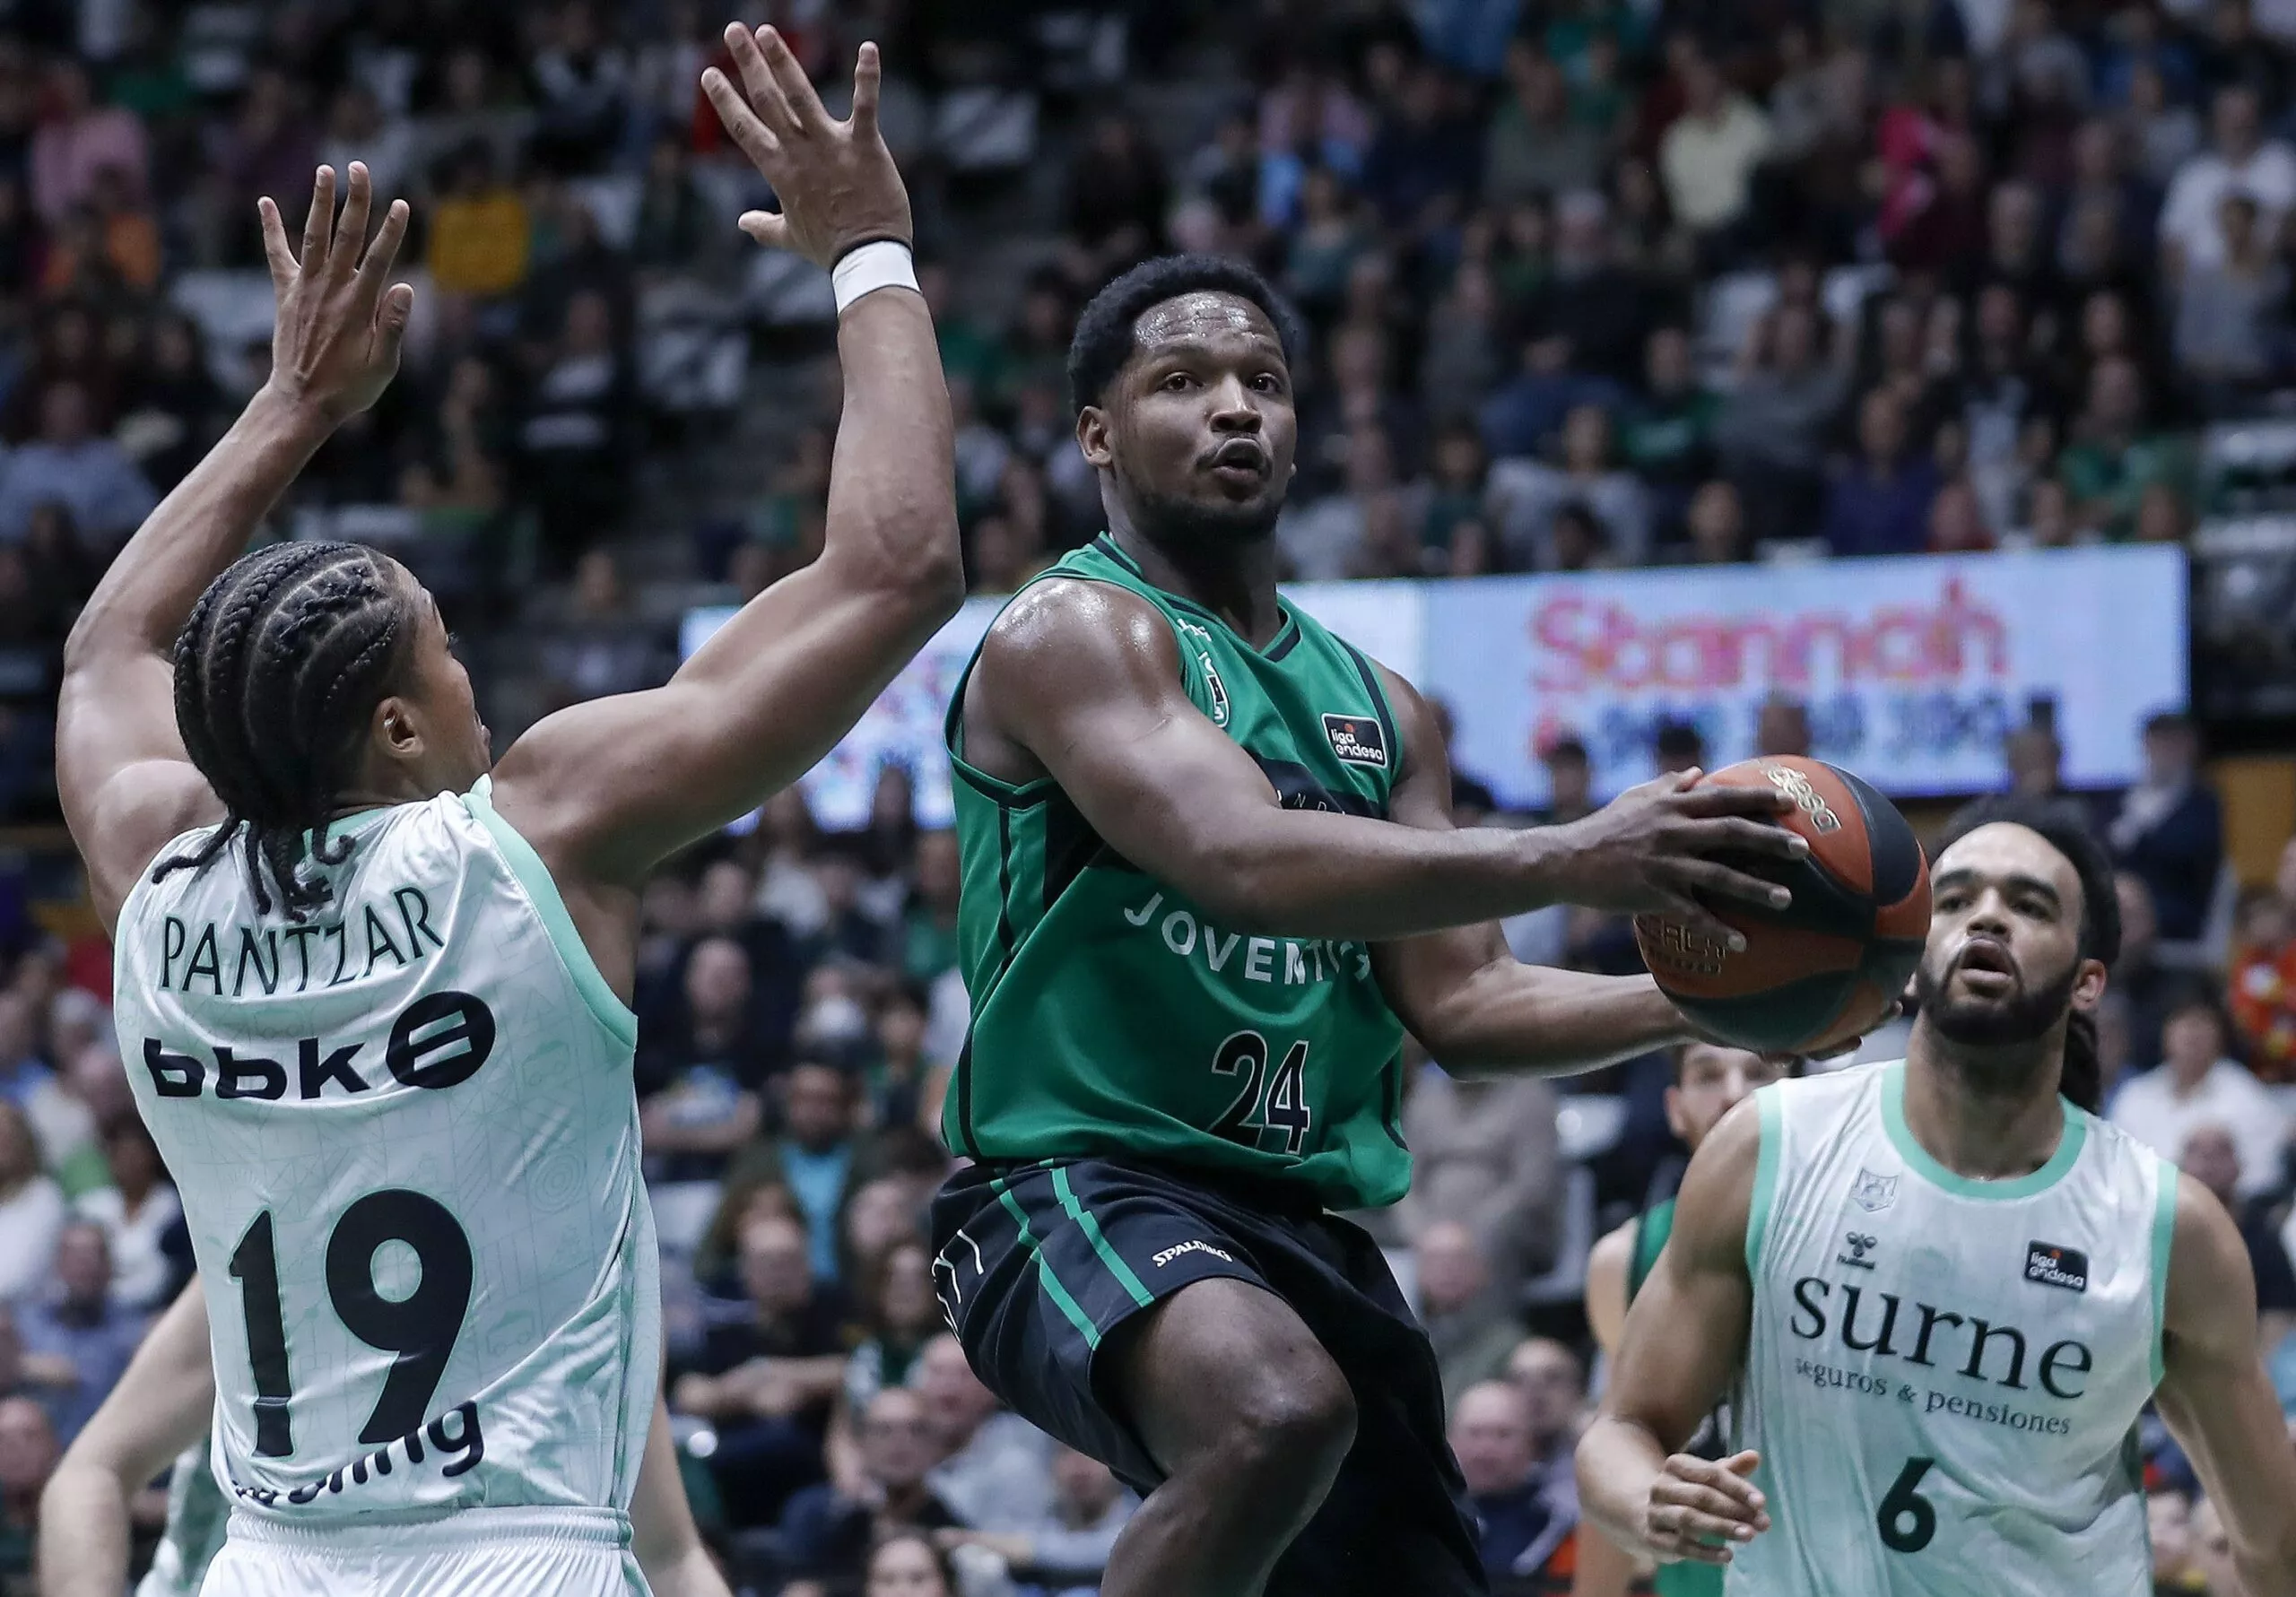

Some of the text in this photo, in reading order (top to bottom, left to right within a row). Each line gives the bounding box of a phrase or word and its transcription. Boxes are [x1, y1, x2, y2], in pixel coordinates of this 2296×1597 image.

[1530, 578, 2007, 696] Stannah
[1330, 728, 1356, 746] liga
[1335, 743, 1384, 761] endesa
[161, 886, 446, 997] PANTZAR
[143, 1037, 372, 1100] bbk
[1205, 1029, 1311, 1157] 24
[2029, 1265, 2085, 1288] endesa
[2030, 1251, 2057, 1269] liga
[229, 1187, 475, 1458] 19
[1790, 1275, 2092, 1399] surne
[1897, 1383, 1918, 1404] &
[1925, 1389, 2071, 1435] pensiones
[1877, 1456, 1937, 1553] 6
